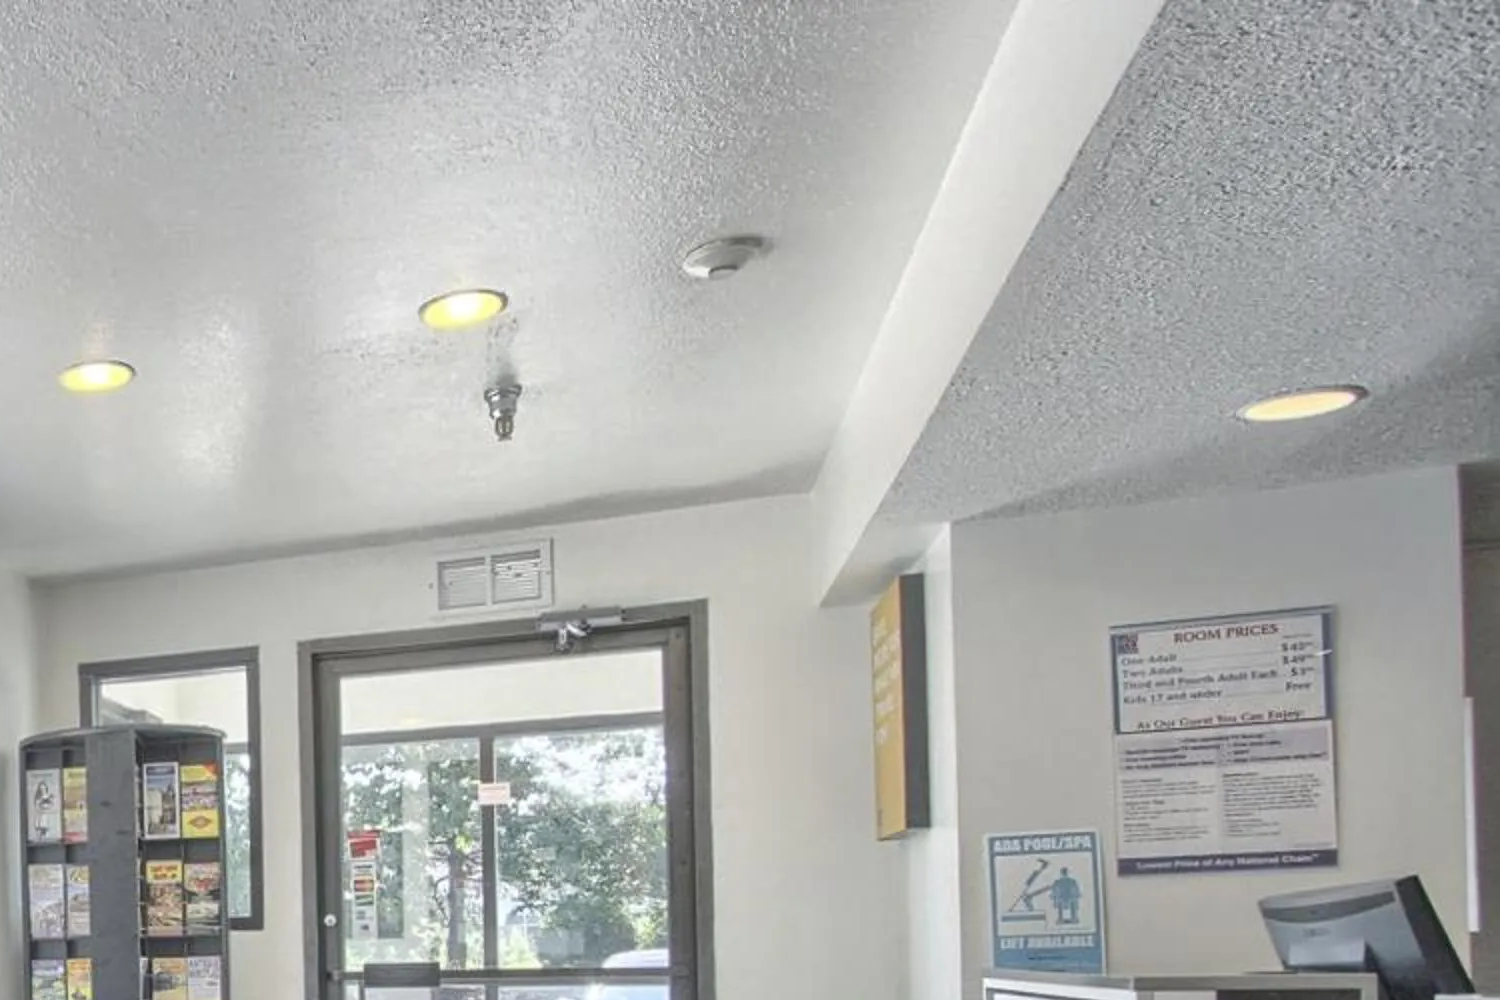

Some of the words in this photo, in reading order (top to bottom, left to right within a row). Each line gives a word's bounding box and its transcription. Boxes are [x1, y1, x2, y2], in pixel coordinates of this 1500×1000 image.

[1173, 628, 1221, 643] ROOM
[1226, 623, 1279, 638] PRICES
[1154, 678, 1175, 687] and
[1177, 674, 1214, 685] Fourth
[1218, 672, 1247, 682] Adult
[1250, 669, 1277, 679] Each
[1166, 692, 1187, 700] and
[1189, 690, 1222, 699] under
[1285, 681, 1313, 691] Free
[1216, 714, 1237, 723] You
[1241, 712, 1264, 721] Can
[1214, 858, 1235, 868] Any
[1236, 855, 1280, 866] National
